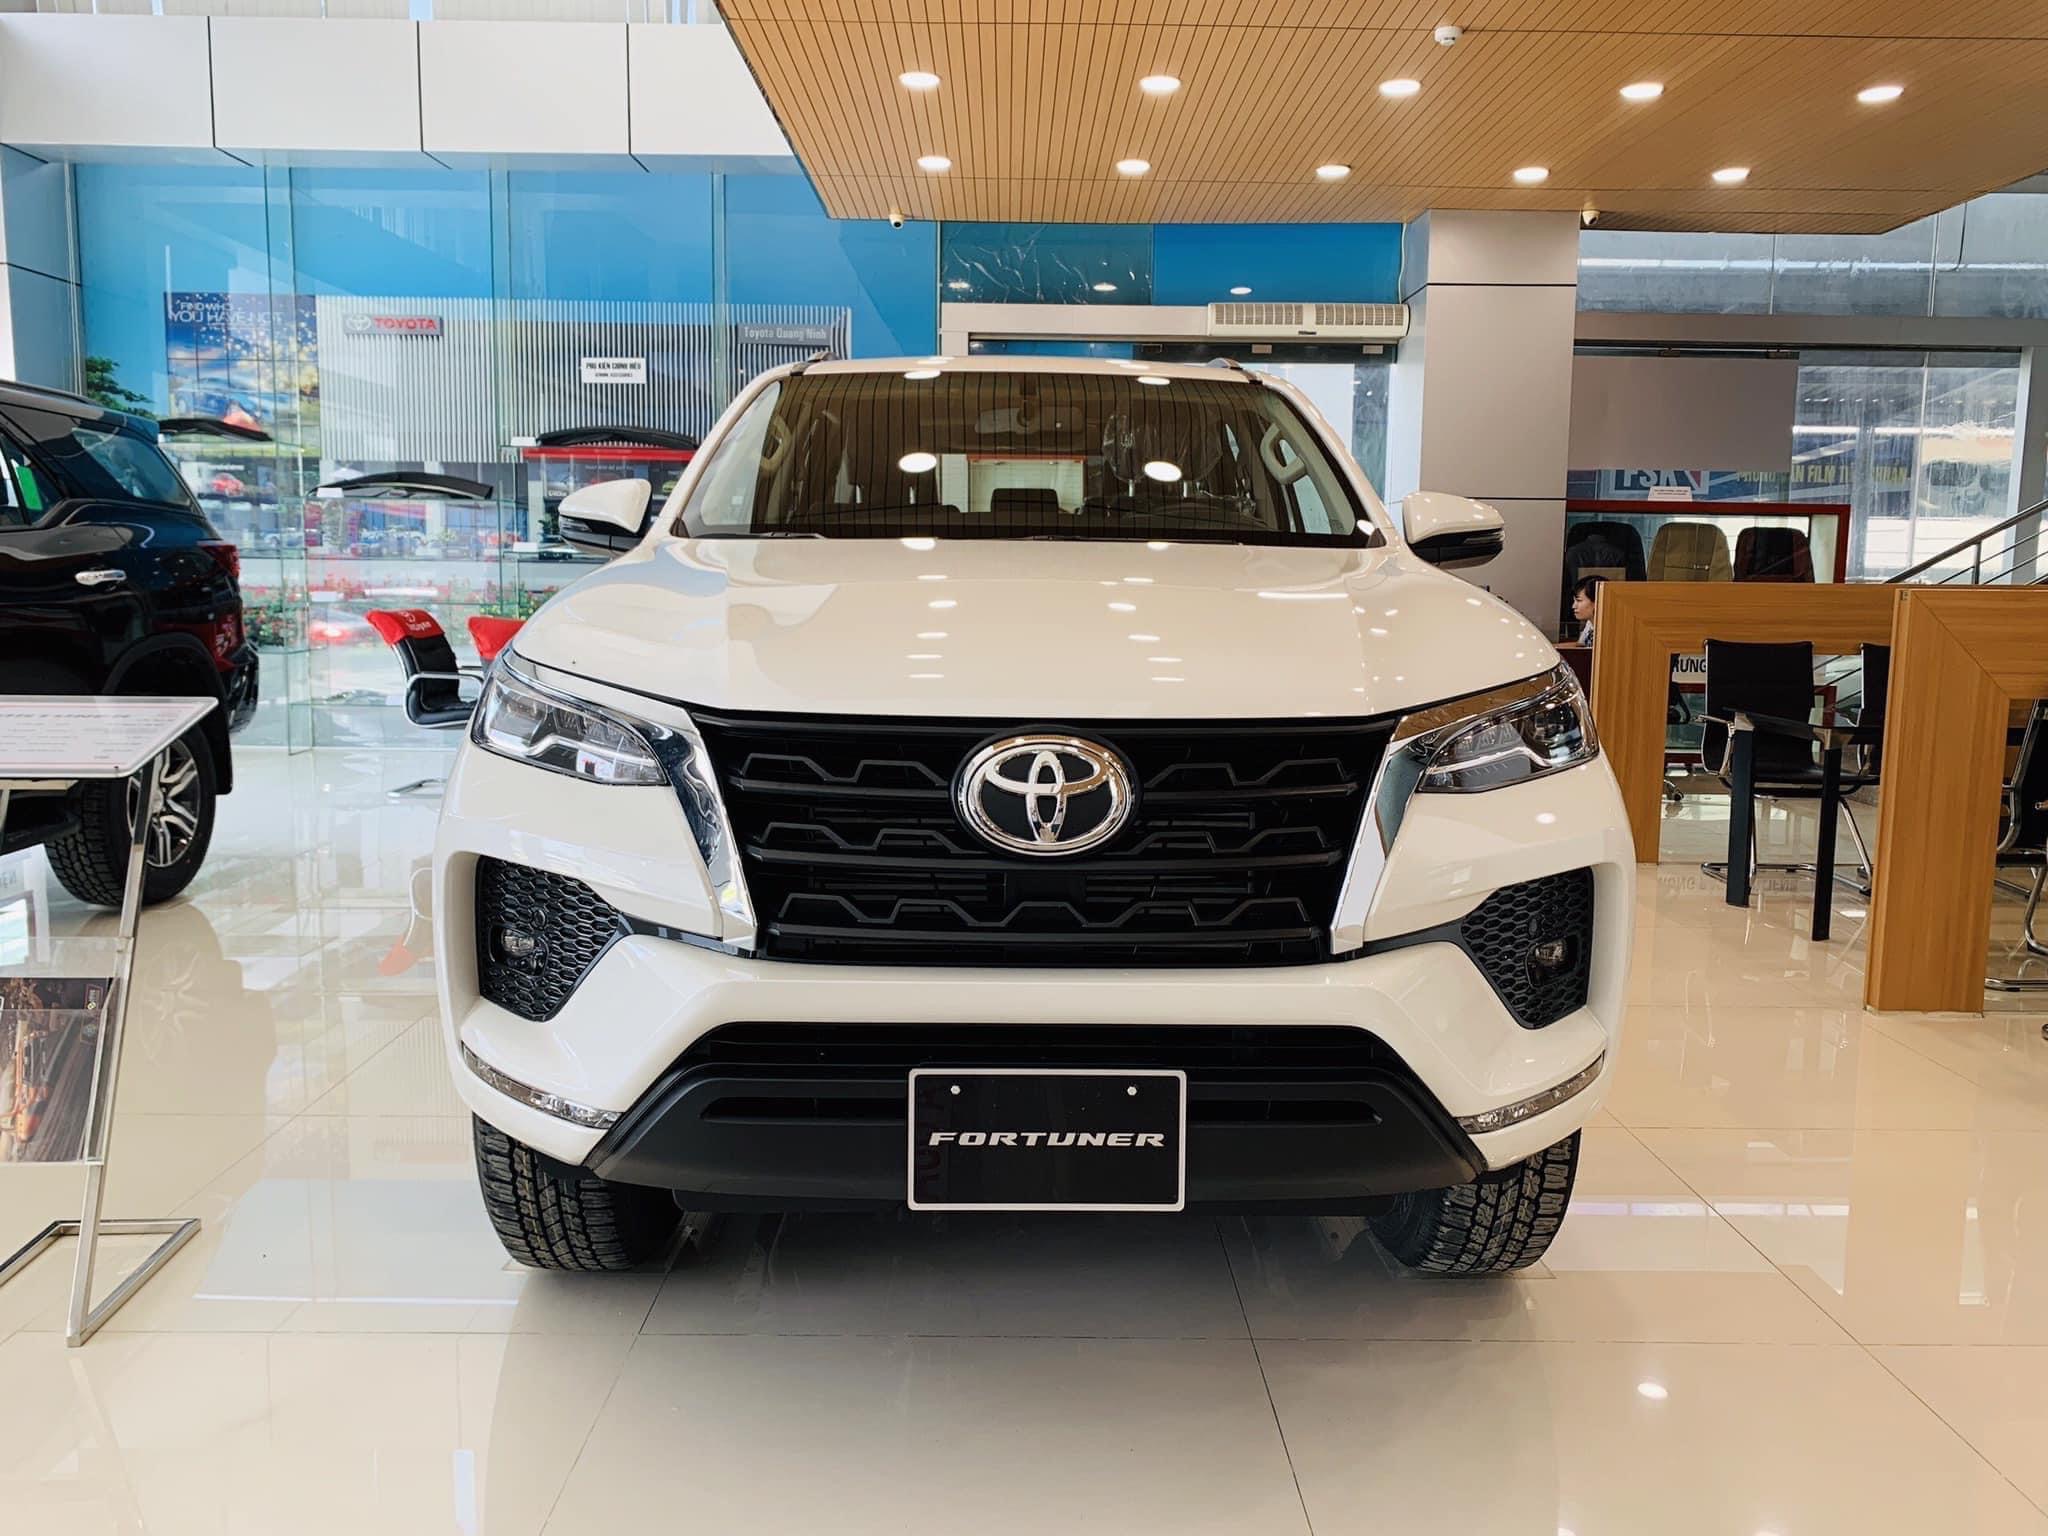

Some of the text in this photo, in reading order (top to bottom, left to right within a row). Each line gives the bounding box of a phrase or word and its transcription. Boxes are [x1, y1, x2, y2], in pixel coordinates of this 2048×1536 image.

[171, 311, 204, 322] YOU
[374, 318, 437, 330] TOYOTA
[744, 326, 774, 340] Toyota
[1807, 464, 1836, 483] FILM
[928, 1132, 1166, 1147] FORTUNER
